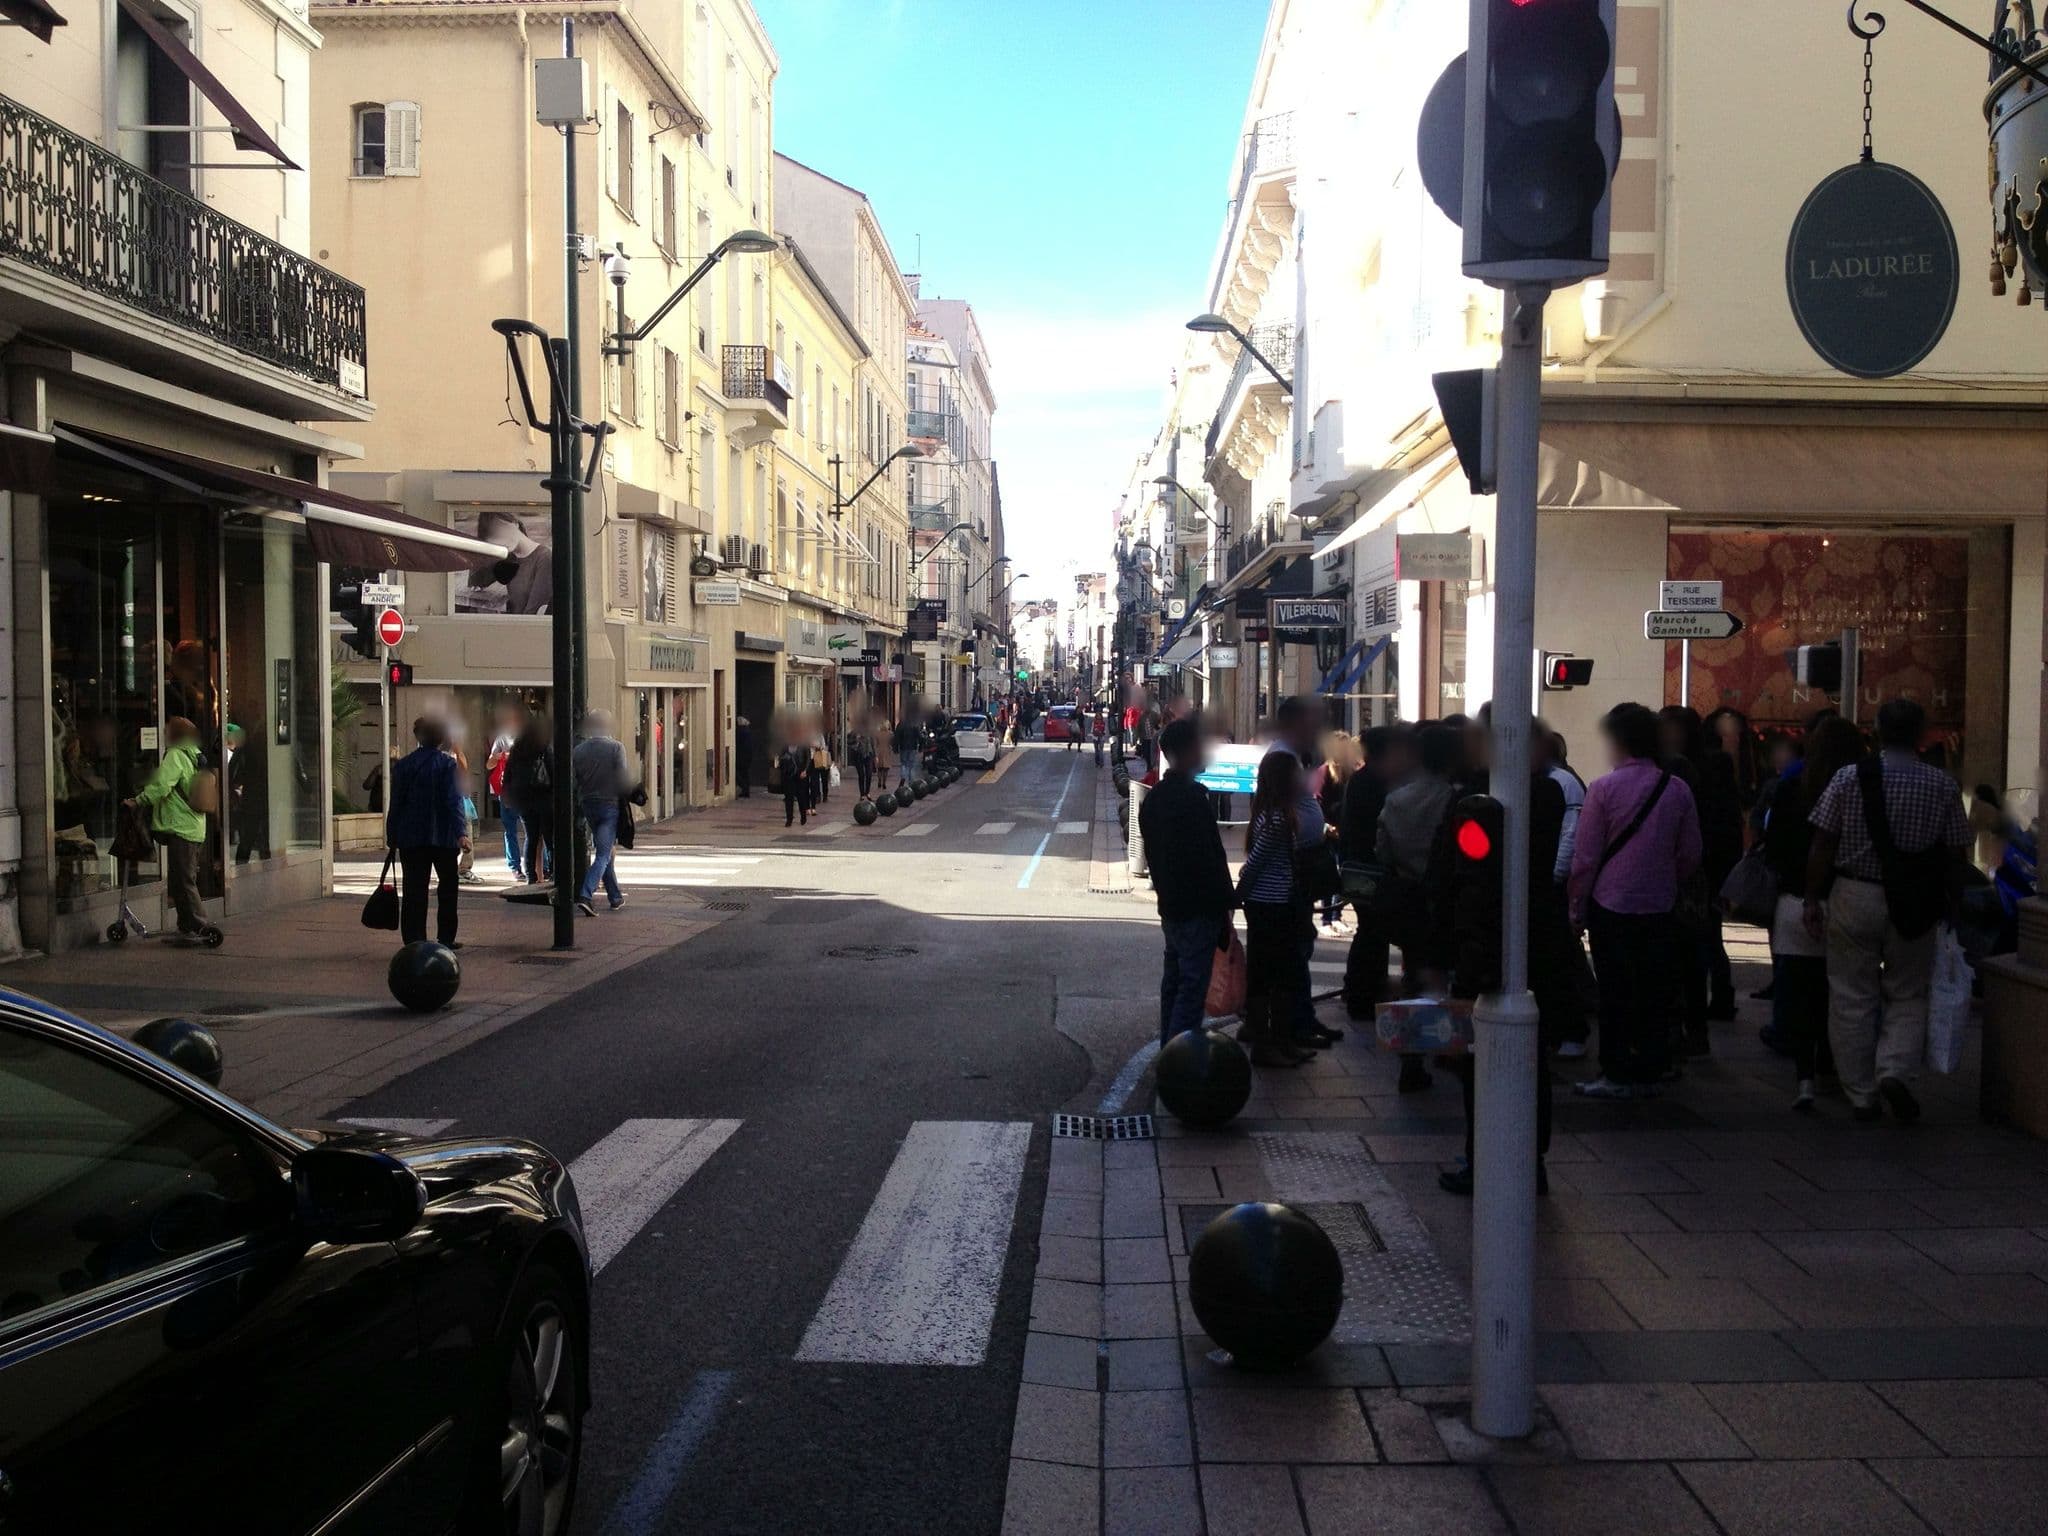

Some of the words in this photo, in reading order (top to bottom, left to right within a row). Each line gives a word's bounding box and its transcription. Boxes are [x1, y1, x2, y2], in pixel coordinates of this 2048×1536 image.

[618, 528, 628, 566] BANANA
[1164, 524, 1174, 589] JULIAN
[618, 569, 629, 600] MOON
[1682, 586, 1701, 594] RUE
[1667, 597, 1717, 606] TEISSEIRE
[1279, 604, 1341, 623] VILEBREQUIN
[1652, 615, 1697, 625] Marché
[1652, 626, 1711, 635] Gambetta
